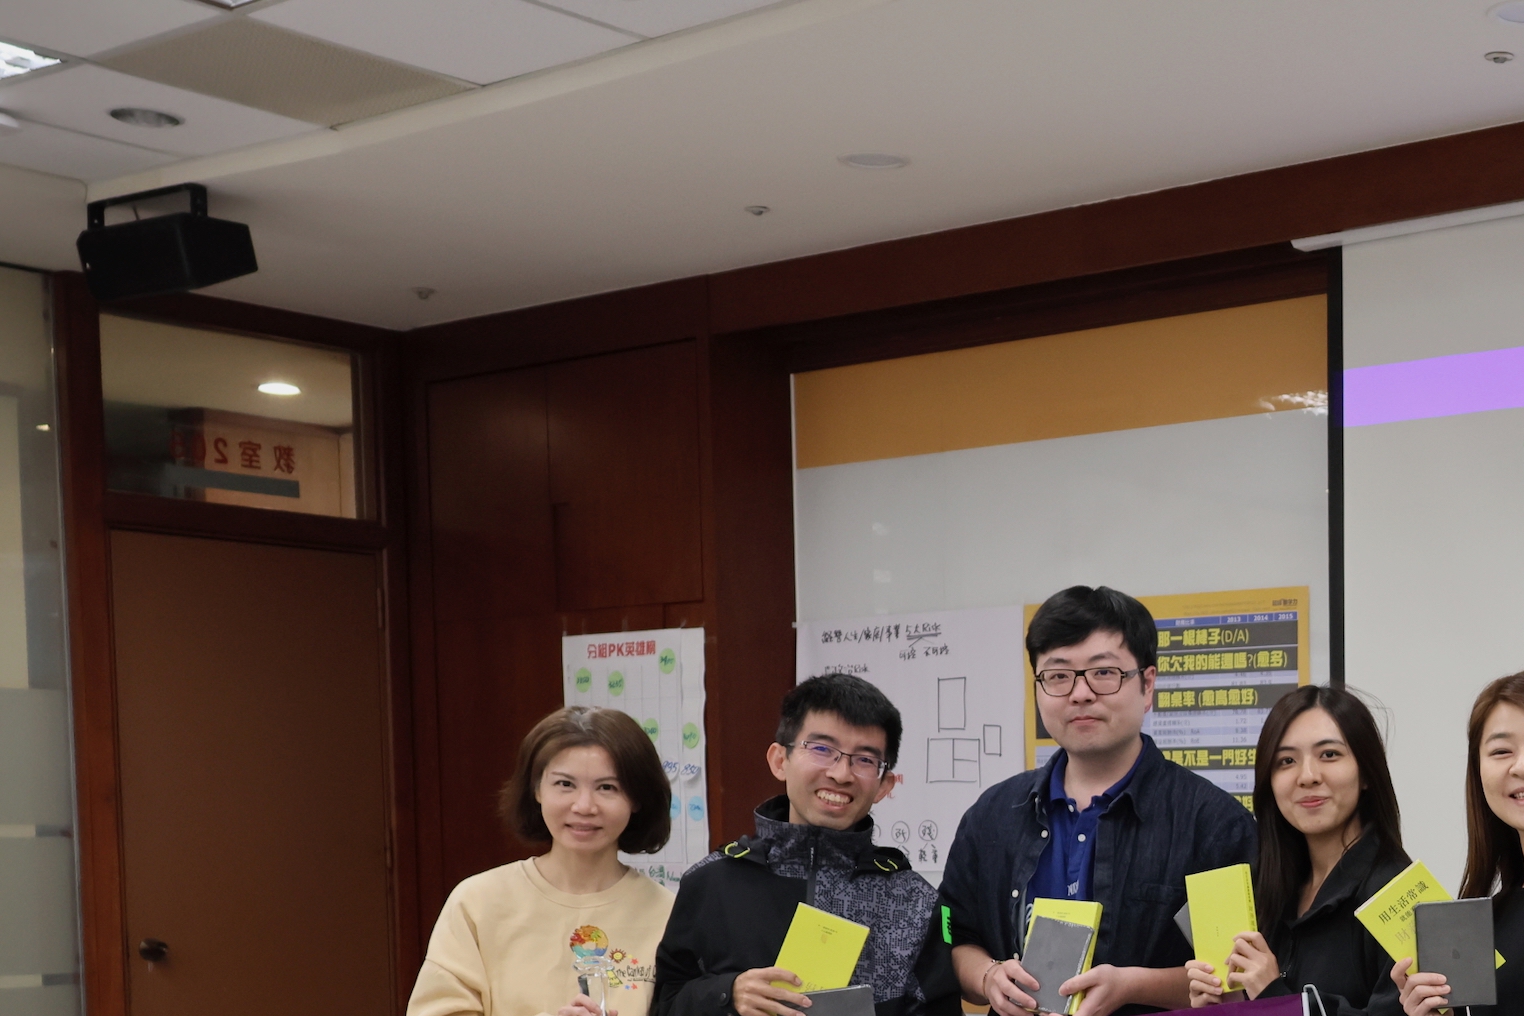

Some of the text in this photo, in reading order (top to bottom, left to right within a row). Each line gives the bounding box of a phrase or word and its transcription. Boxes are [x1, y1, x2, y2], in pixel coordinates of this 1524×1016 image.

[1378, 880, 1430, 925] 用生活常識
